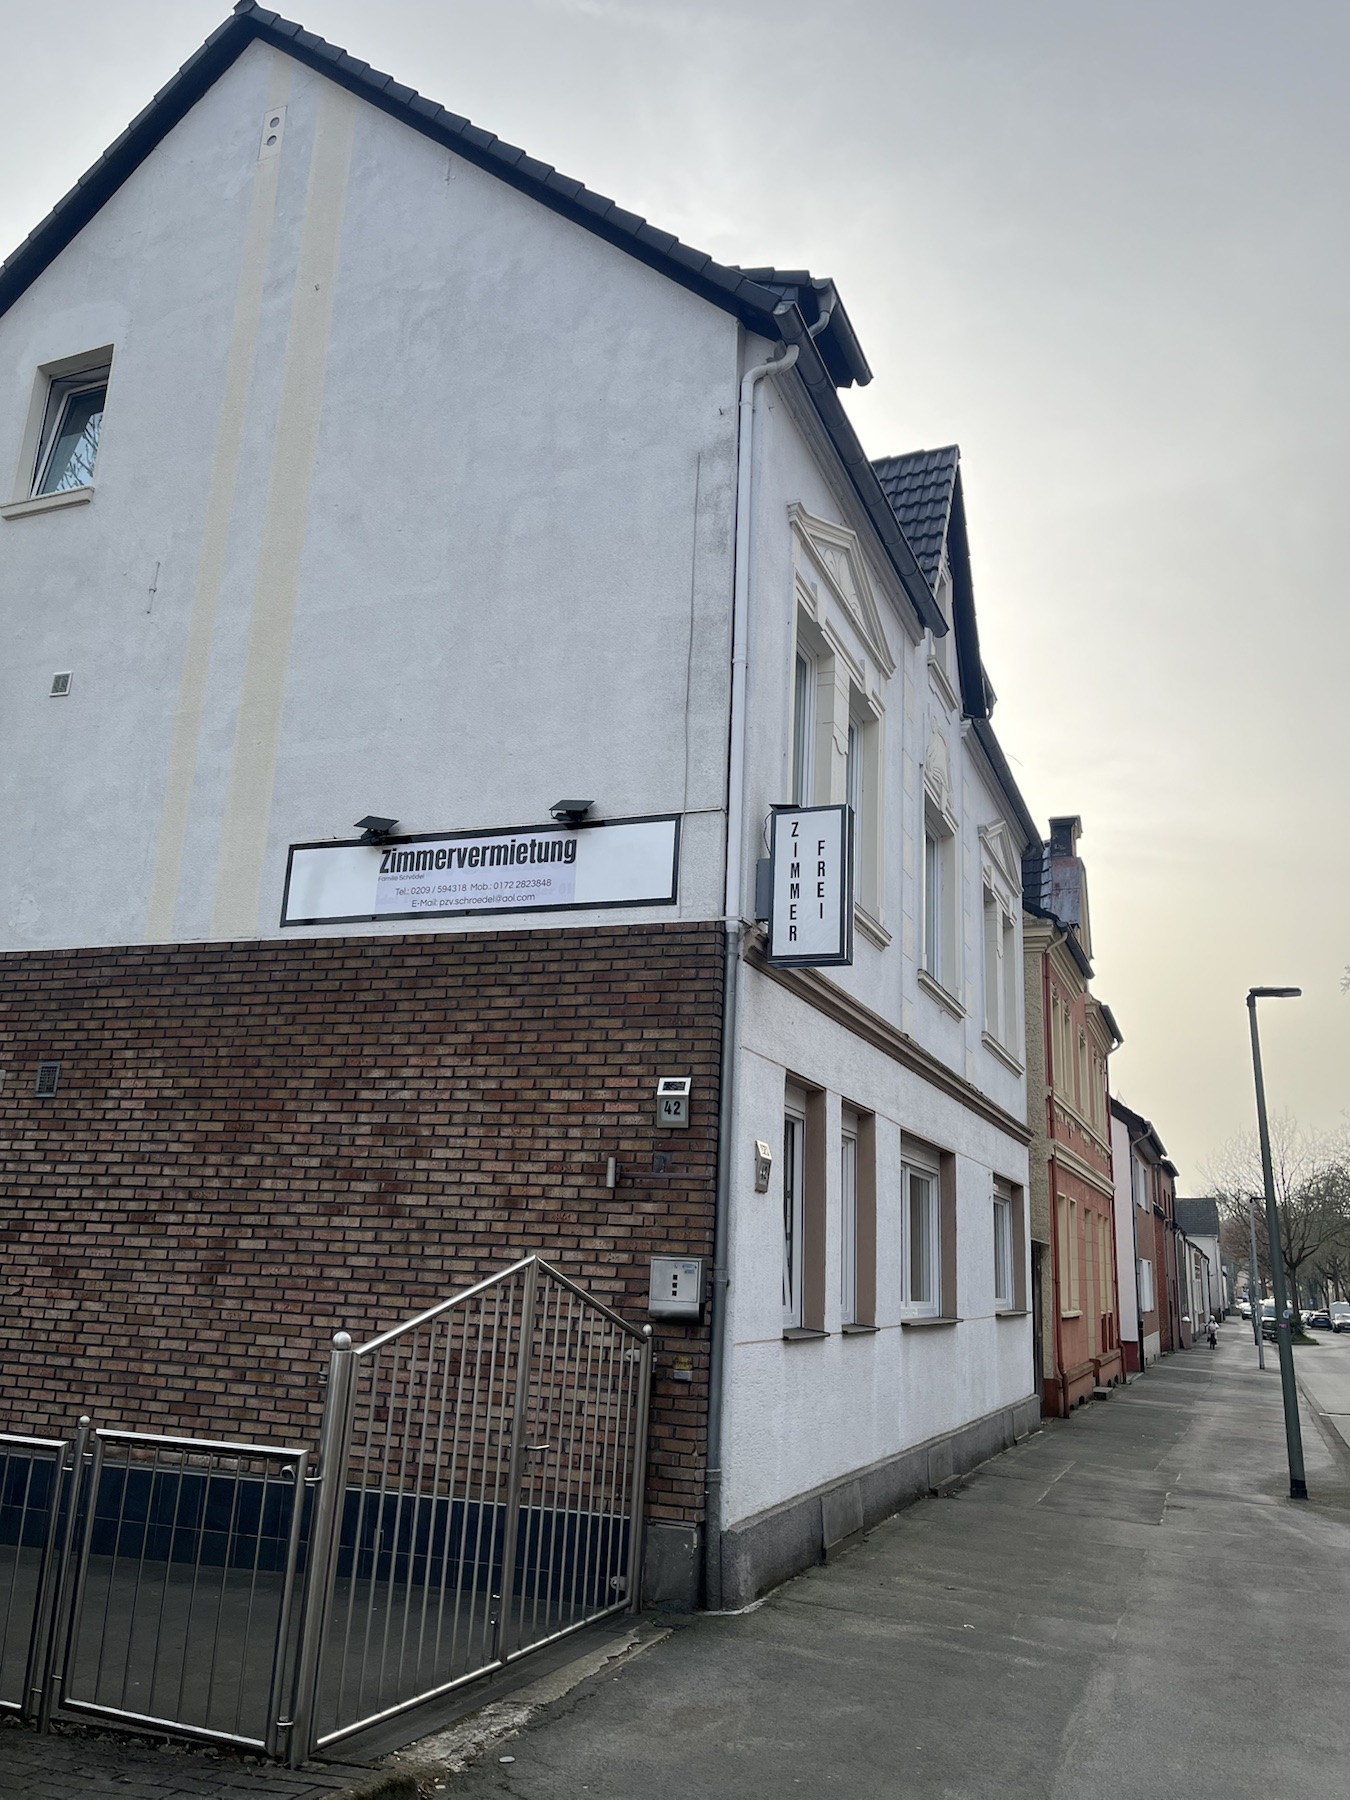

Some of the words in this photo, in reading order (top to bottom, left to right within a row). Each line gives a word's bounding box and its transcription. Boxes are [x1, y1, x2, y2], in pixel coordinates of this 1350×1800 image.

[379, 839, 577, 873] Zimmervermietung
[410, 886, 431, 895] 0209
[437, 884, 467, 893] 594318
[470, 883, 492, 891] Mob.:
[493, 881, 514, 890] 0172
[515, 878, 552, 888] 2823848
[789, 822, 800, 941] ZIMMER
[817, 840, 826, 919] FREI
[439, 894, 535, 908] pzv.schroedel@aol.com
[663, 1100, 681, 1116] 42
